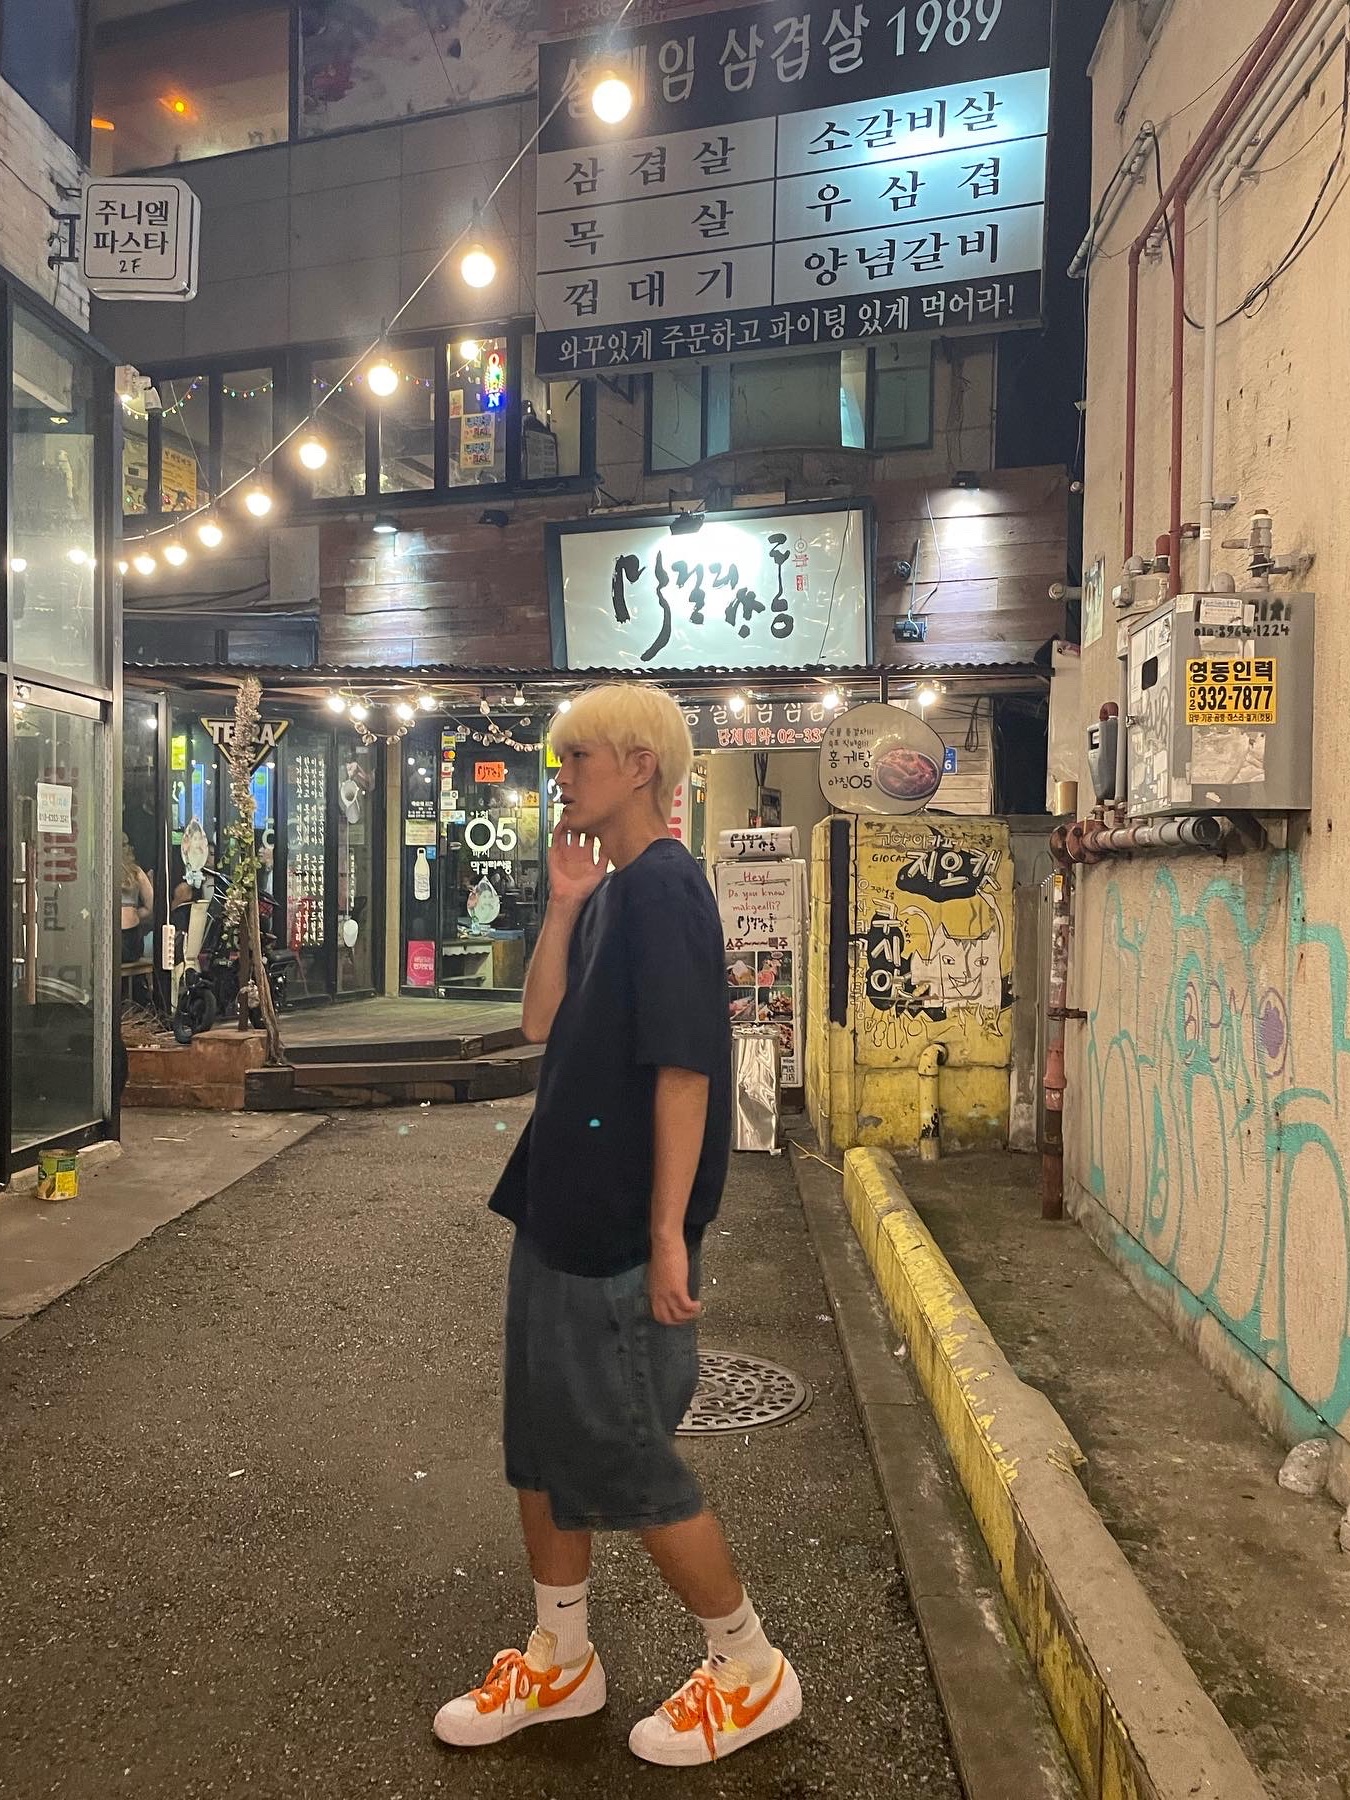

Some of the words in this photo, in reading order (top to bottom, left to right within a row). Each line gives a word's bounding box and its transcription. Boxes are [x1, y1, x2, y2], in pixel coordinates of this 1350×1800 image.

[719, 5, 869, 93] 삼겹살
[885, 0, 1001, 57] 1989
[807, 91, 1003, 155] 소갈비살
[94, 198, 170, 227] 주니엘
[93, 230, 169, 256] 파스타
[804, 223, 1001, 288] 양념갈비
[118, 259, 142, 275] 2F
[560, 331, 652, 368] 와꾸있게
[660, 318, 762, 357] 주문하고
[770, 306, 846, 347] 파이팅
[858, 296, 909, 336] 있게
[920, 284, 1015, 324] 먹어라!
[487, 353, 501, 408] ON
[1189, 661, 1273, 683] 영동인력
[872, 853, 907, 863] GIOCAT
[906, 849, 1002, 891] 지오캣
[744, 871, 770, 883] Hey!
[728, 889, 739, 898] Do
[743, 890, 757, 900] you
[762, 888, 785, 897] know
